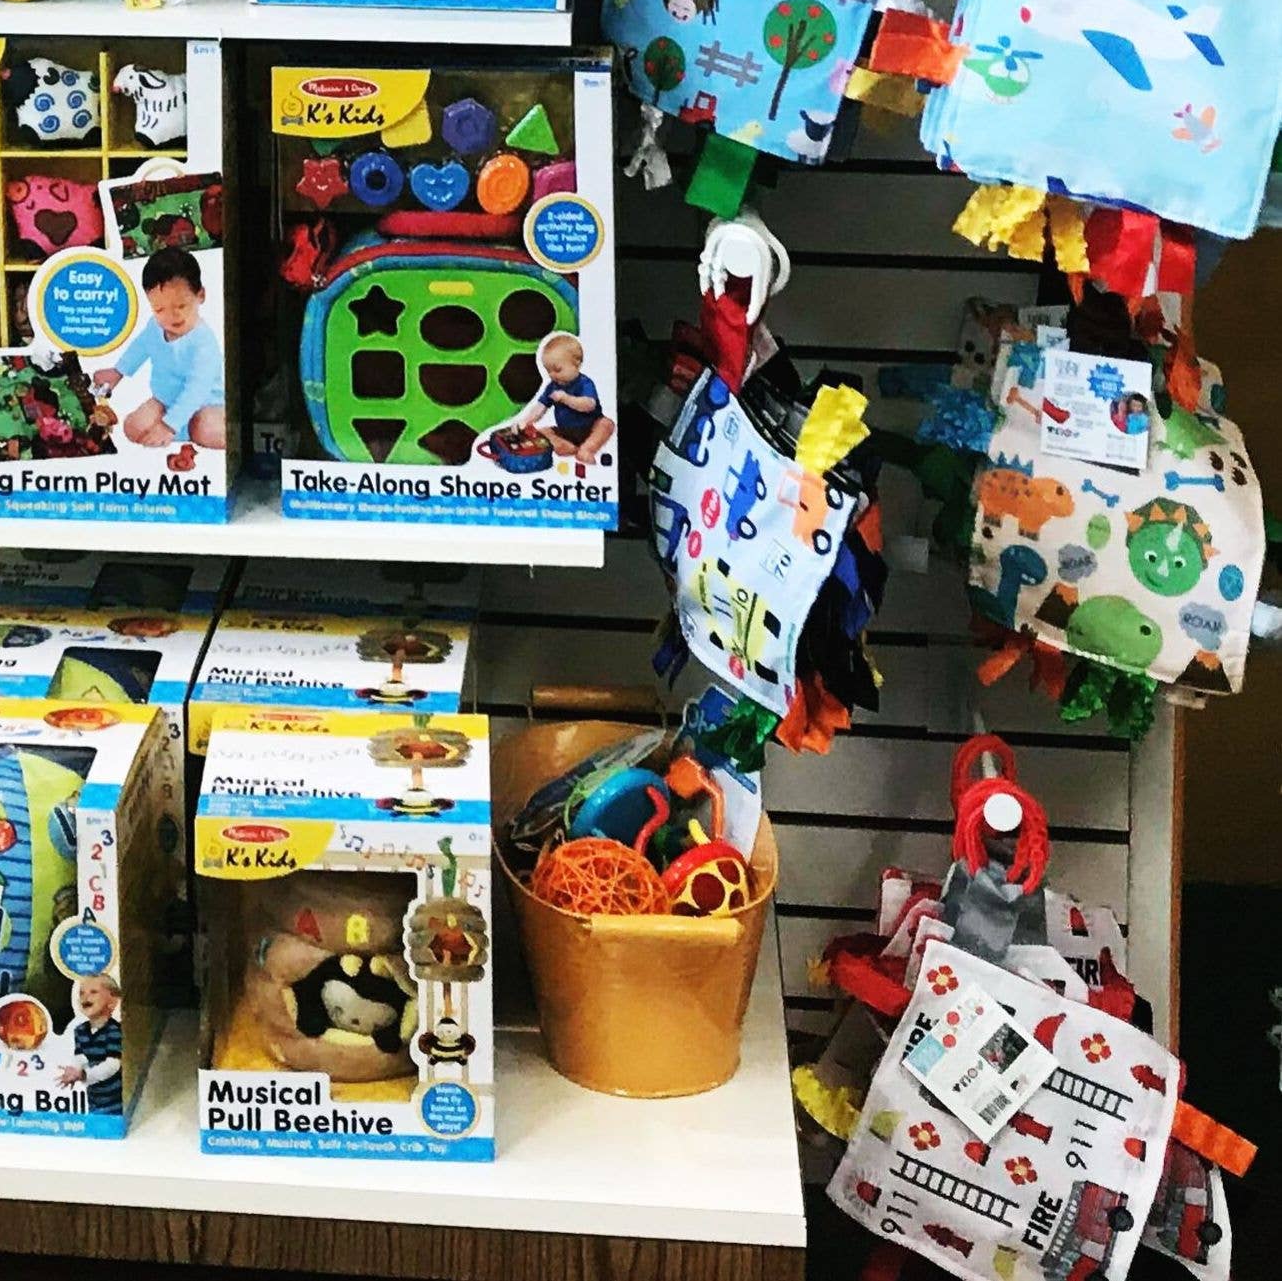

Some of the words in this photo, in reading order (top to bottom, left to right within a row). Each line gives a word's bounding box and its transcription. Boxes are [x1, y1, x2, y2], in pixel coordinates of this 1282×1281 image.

[307, 103, 334, 124] K's
[339, 104, 386, 125] Kids
[68, 270, 103, 288] Easy
[53, 287, 69, 301] to
[73, 287, 119, 305] carry!
[21, 470, 87, 494] Farm
[96, 472, 151, 500] Play
[159, 473, 211, 497] Mat
[291, 470, 430, 497] Take-Along
[440, 475, 521, 500] Shape
[532, 478, 612, 503] Sorter
[210, 666, 294, 678] Musical
[207, 675, 247, 684] Pull
[255, 677, 344, 689] Beehive
[214, 776, 305, 787] Musical
[211, 785, 255, 796] Pull
[265, 787, 362, 798] Beehive
[101, 829, 115, 846] 3
[91, 843, 102, 860] 2
[226, 847, 251, 867] K's
[256, 848, 297, 869] Kids
[93, 894, 105, 911] B
[82, 906, 97, 925] A
[17, 1060, 29, 1076] 2
[31, 1055, 45, 1071] 3
[207, 1080, 321, 1105] Musical
[36, 1090, 86, 1115] Ball
[208, 1108, 261, 1132] Pull
[274, 1109, 393, 1135] Beehive
[1065, 1118, 1097, 1170] 911
[880, 1191, 918, 1236] 911
[1021, 1190, 1063, 1251] FIRE
